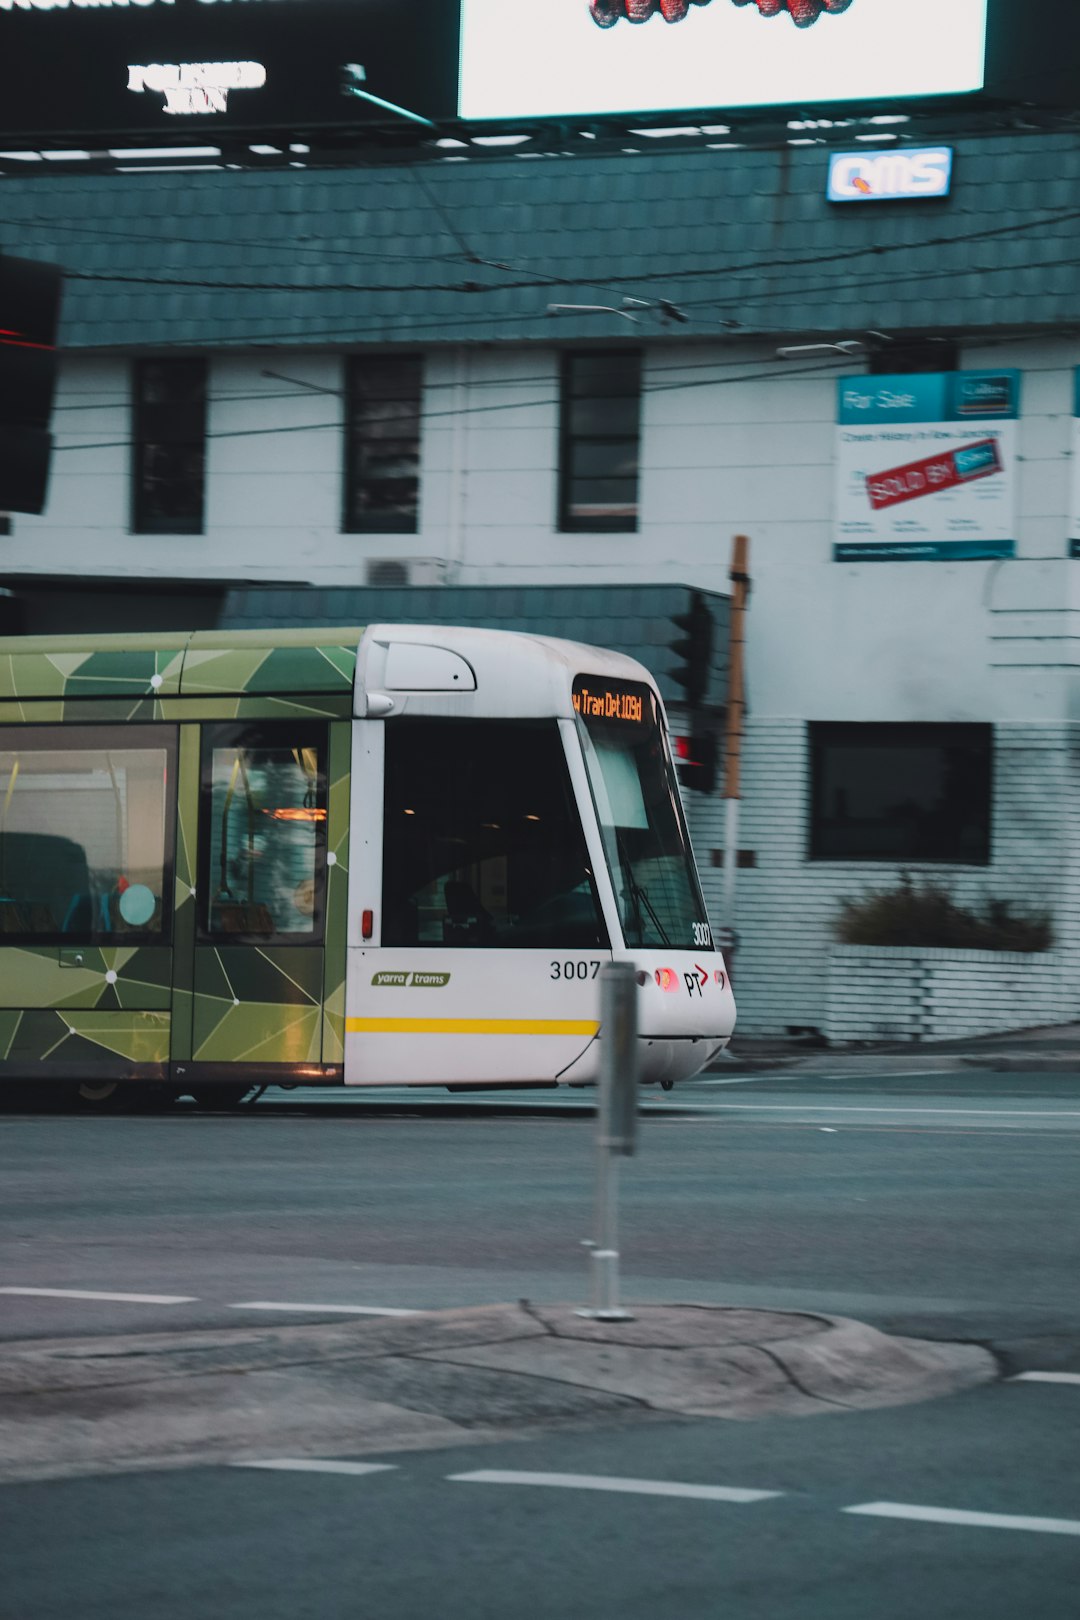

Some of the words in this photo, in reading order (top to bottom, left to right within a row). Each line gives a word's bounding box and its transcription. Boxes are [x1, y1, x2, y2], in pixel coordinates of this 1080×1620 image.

[581, 689, 604, 717] Tram
[692, 922, 711, 947] 3007
[377, 973, 405, 985] yarra
[414, 973, 445, 985] trams
[550, 961, 601, 980] 3007
